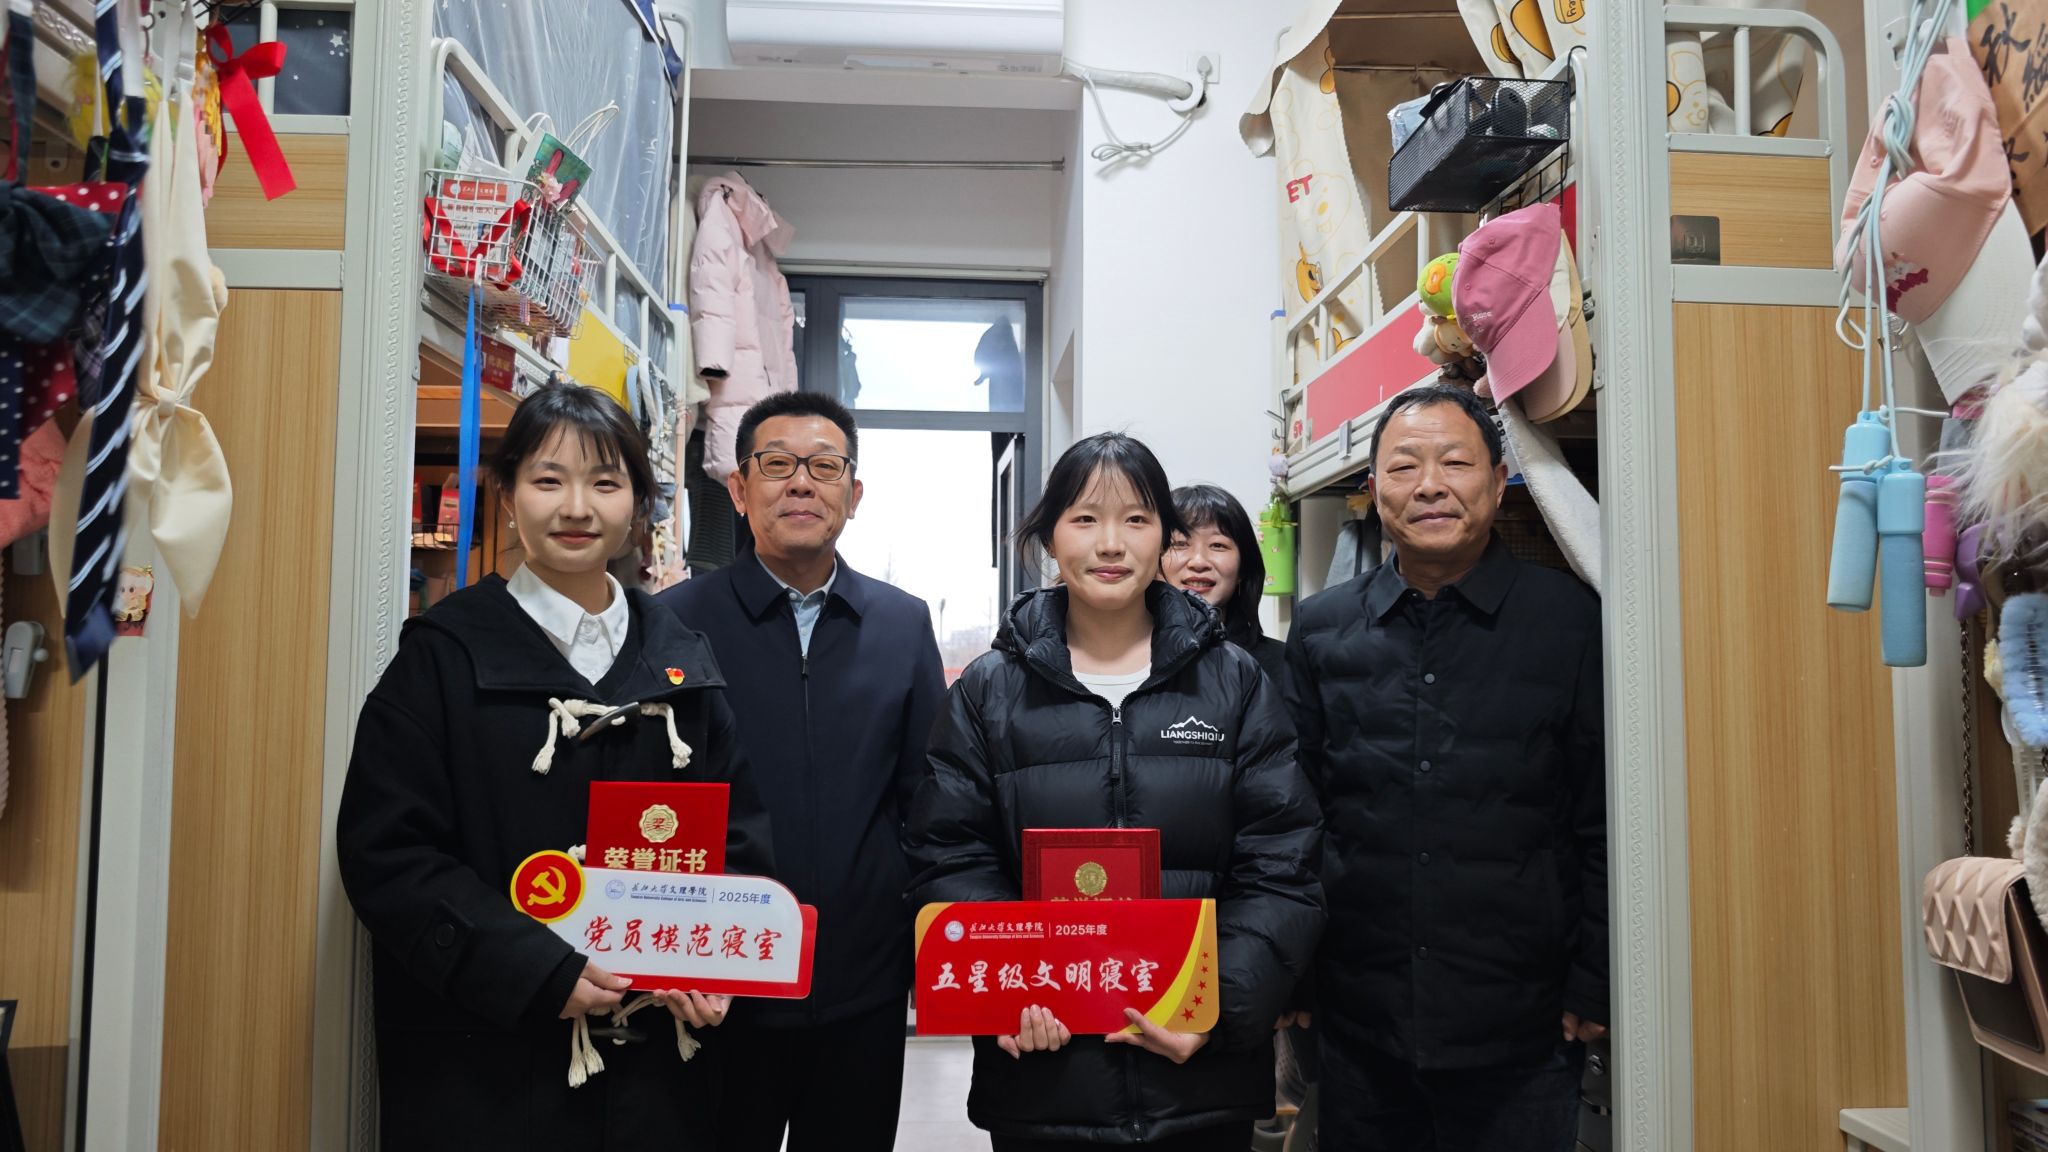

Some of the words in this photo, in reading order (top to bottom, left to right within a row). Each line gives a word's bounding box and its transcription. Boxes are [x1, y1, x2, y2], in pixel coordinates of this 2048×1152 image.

[1160, 730, 1225, 742] LIANGSHIQIU
[604, 846, 708, 874] 荣誉证书
[719, 891, 771, 905] 2025年度
[583, 914, 782, 961] 党员模范寝室
[1055, 924, 1108, 936] 2025年度
[931, 957, 1160, 993] 五星级文明寝室
